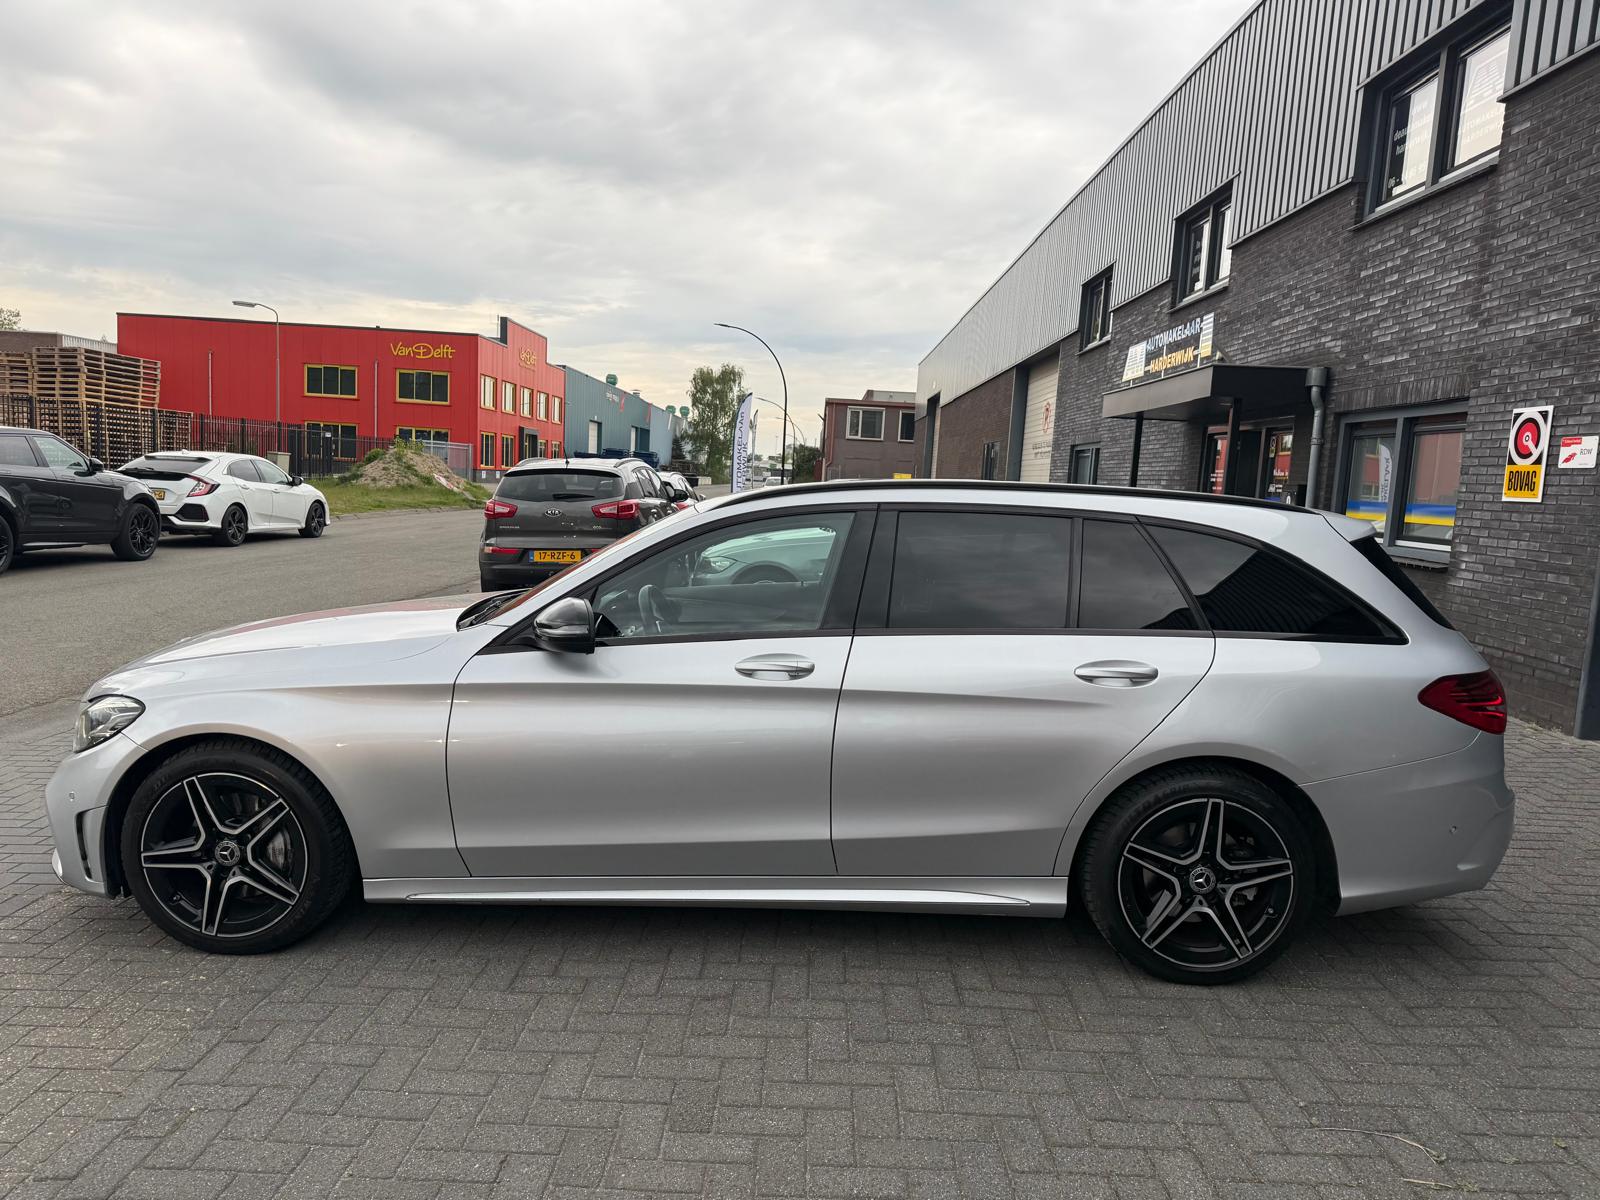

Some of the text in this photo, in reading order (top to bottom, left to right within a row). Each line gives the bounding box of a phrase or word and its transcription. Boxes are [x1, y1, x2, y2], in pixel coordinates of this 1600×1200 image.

[1146, 317, 1201, 352] AUTOMAKELAAR
[390, 341, 456, 359] Van Delft
[1150, 345, 1195, 374] HARDERWIJK
[1507, 470, 1537, 492] BOVAG
[538, 551, 576, 560] 17-RZF-6
